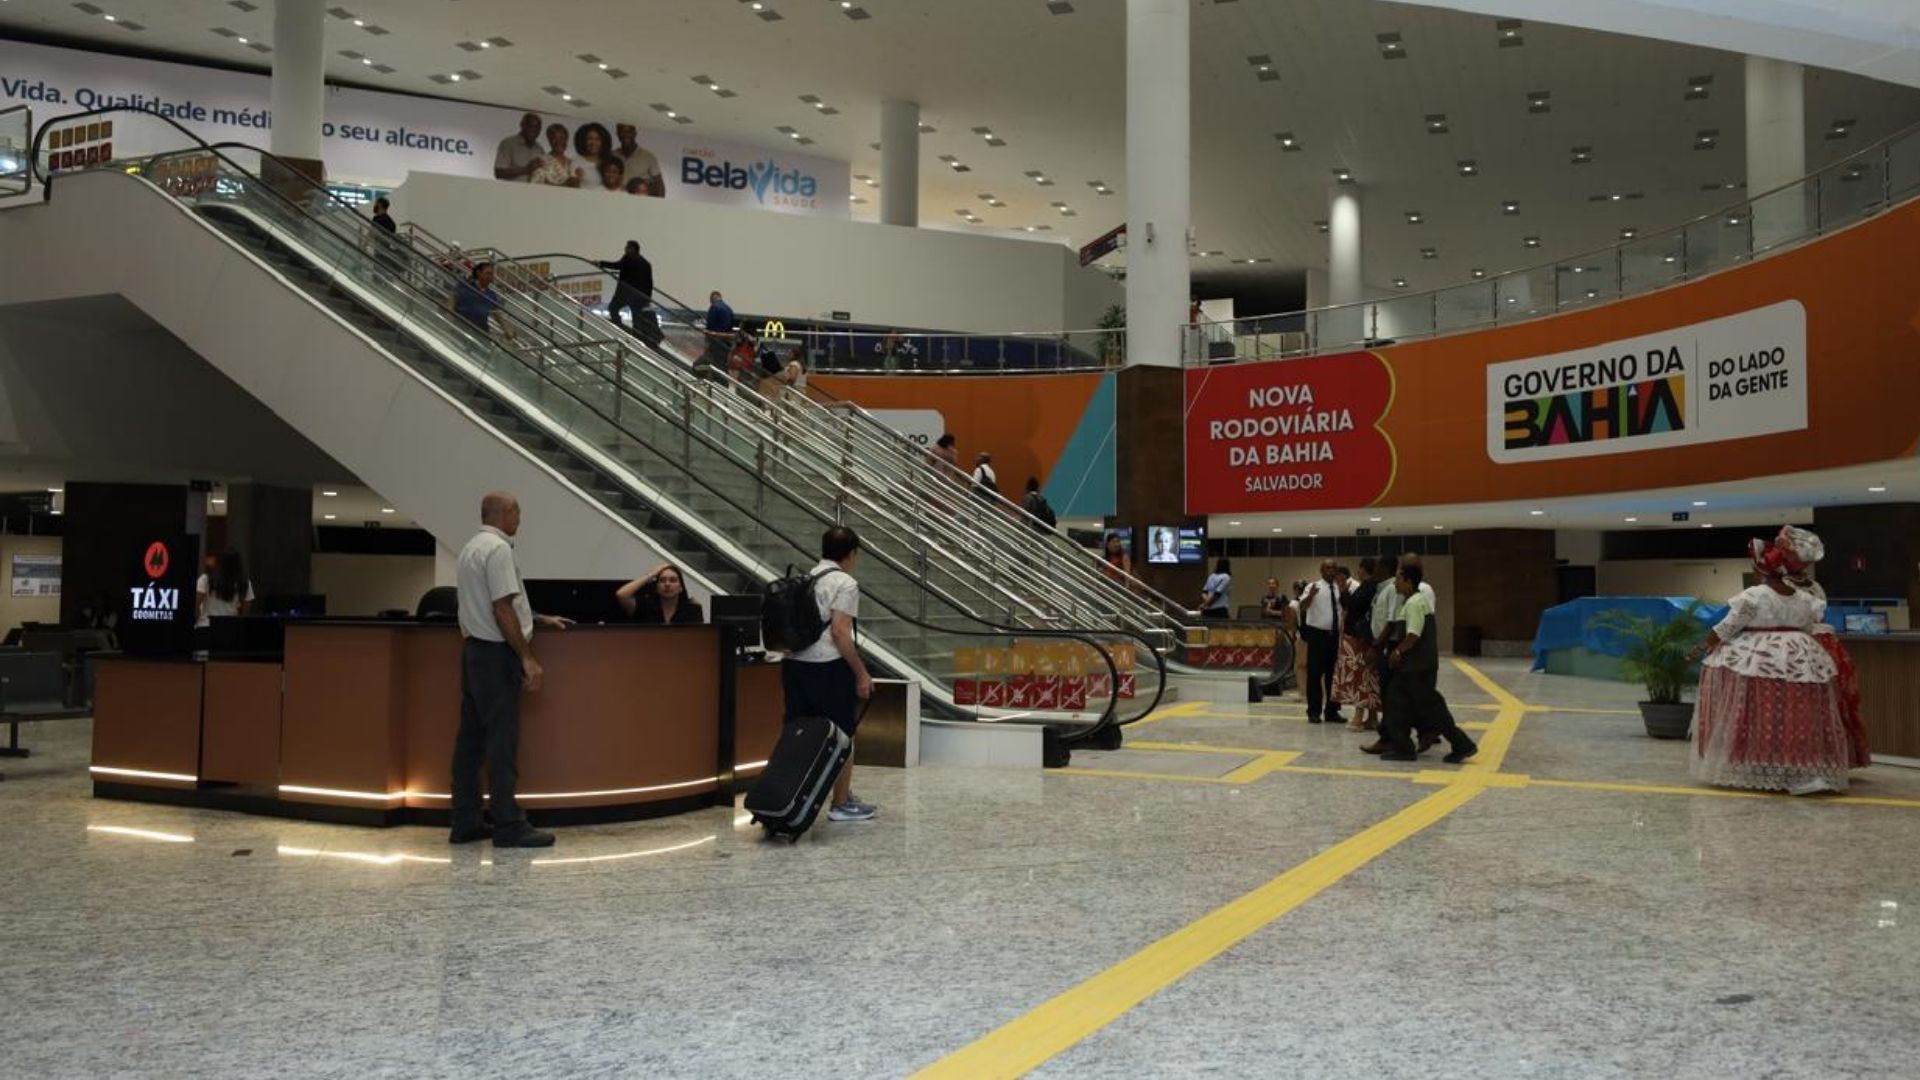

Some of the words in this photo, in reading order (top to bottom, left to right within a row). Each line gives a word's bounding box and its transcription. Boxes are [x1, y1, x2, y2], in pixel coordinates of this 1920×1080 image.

[1, 77, 68, 104] Vida.
[75, 88, 207, 122] Qualidade
[213, 103, 272, 129] médi
[322, 122, 334, 137] o
[340, 123, 379, 142] seu
[385, 127, 474, 155] alcance.
[1504, 354, 1637, 398] GOVERNO
[1647, 346, 1685, 377] DA
[1709, 358, 1735, 378] DO
[1739, 347, 1785, 373] LADO
[1249, 384, 1312, 407] NOVA
[1709, 381, 1732, 401] DA
[1735, 369, 1788, 395] GENTE
[1210, 406, 1354, 440] RODOVIÁRIA
[1504, 375, 1685, 450] BAHIA
[1229, 446, 1260, 466] DA
[1266, 441, 1334, 465] BAHIA
[1245, 473, 1323, 492] SALVADOR
[131, 581, 179, 610] TÁXI
